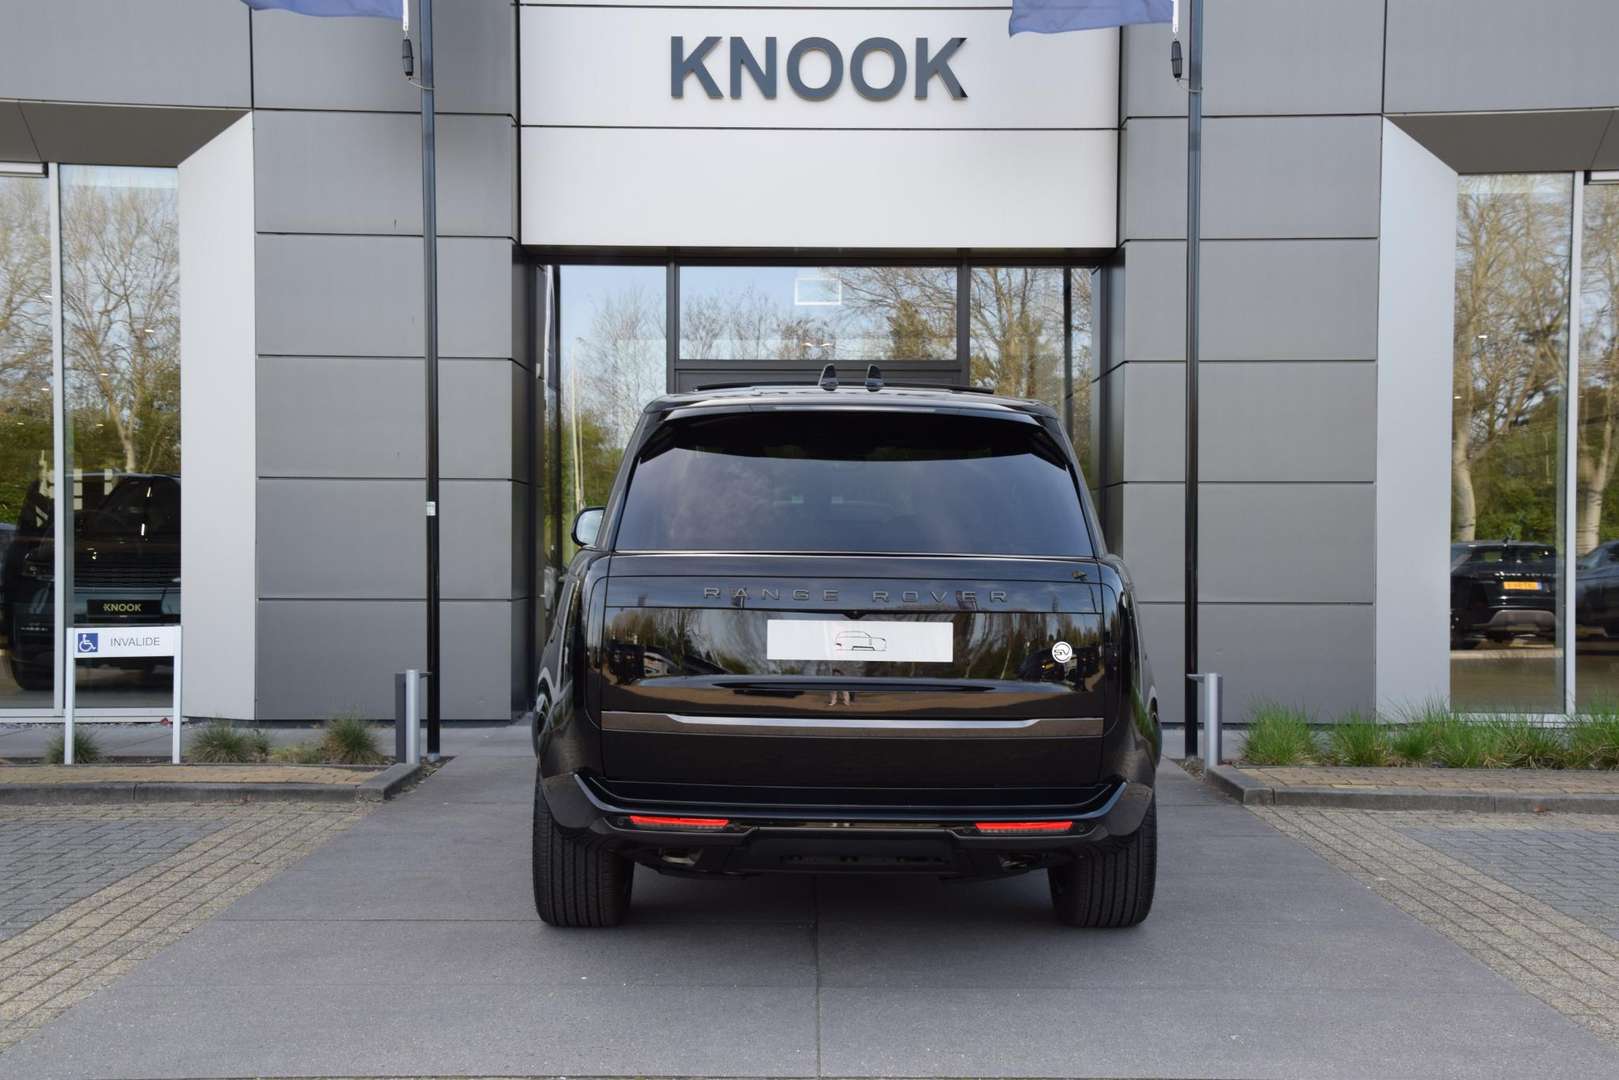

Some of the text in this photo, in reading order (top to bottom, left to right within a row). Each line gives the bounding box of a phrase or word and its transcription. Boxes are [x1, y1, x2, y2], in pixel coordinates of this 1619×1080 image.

[671, 36, 968, 101] KNOOK
[703, 587, 1007, 603] RANGE ROVER
[103, 603, 142, 612] KNOOK
[110, 637, 160, 648] INVALIDE
